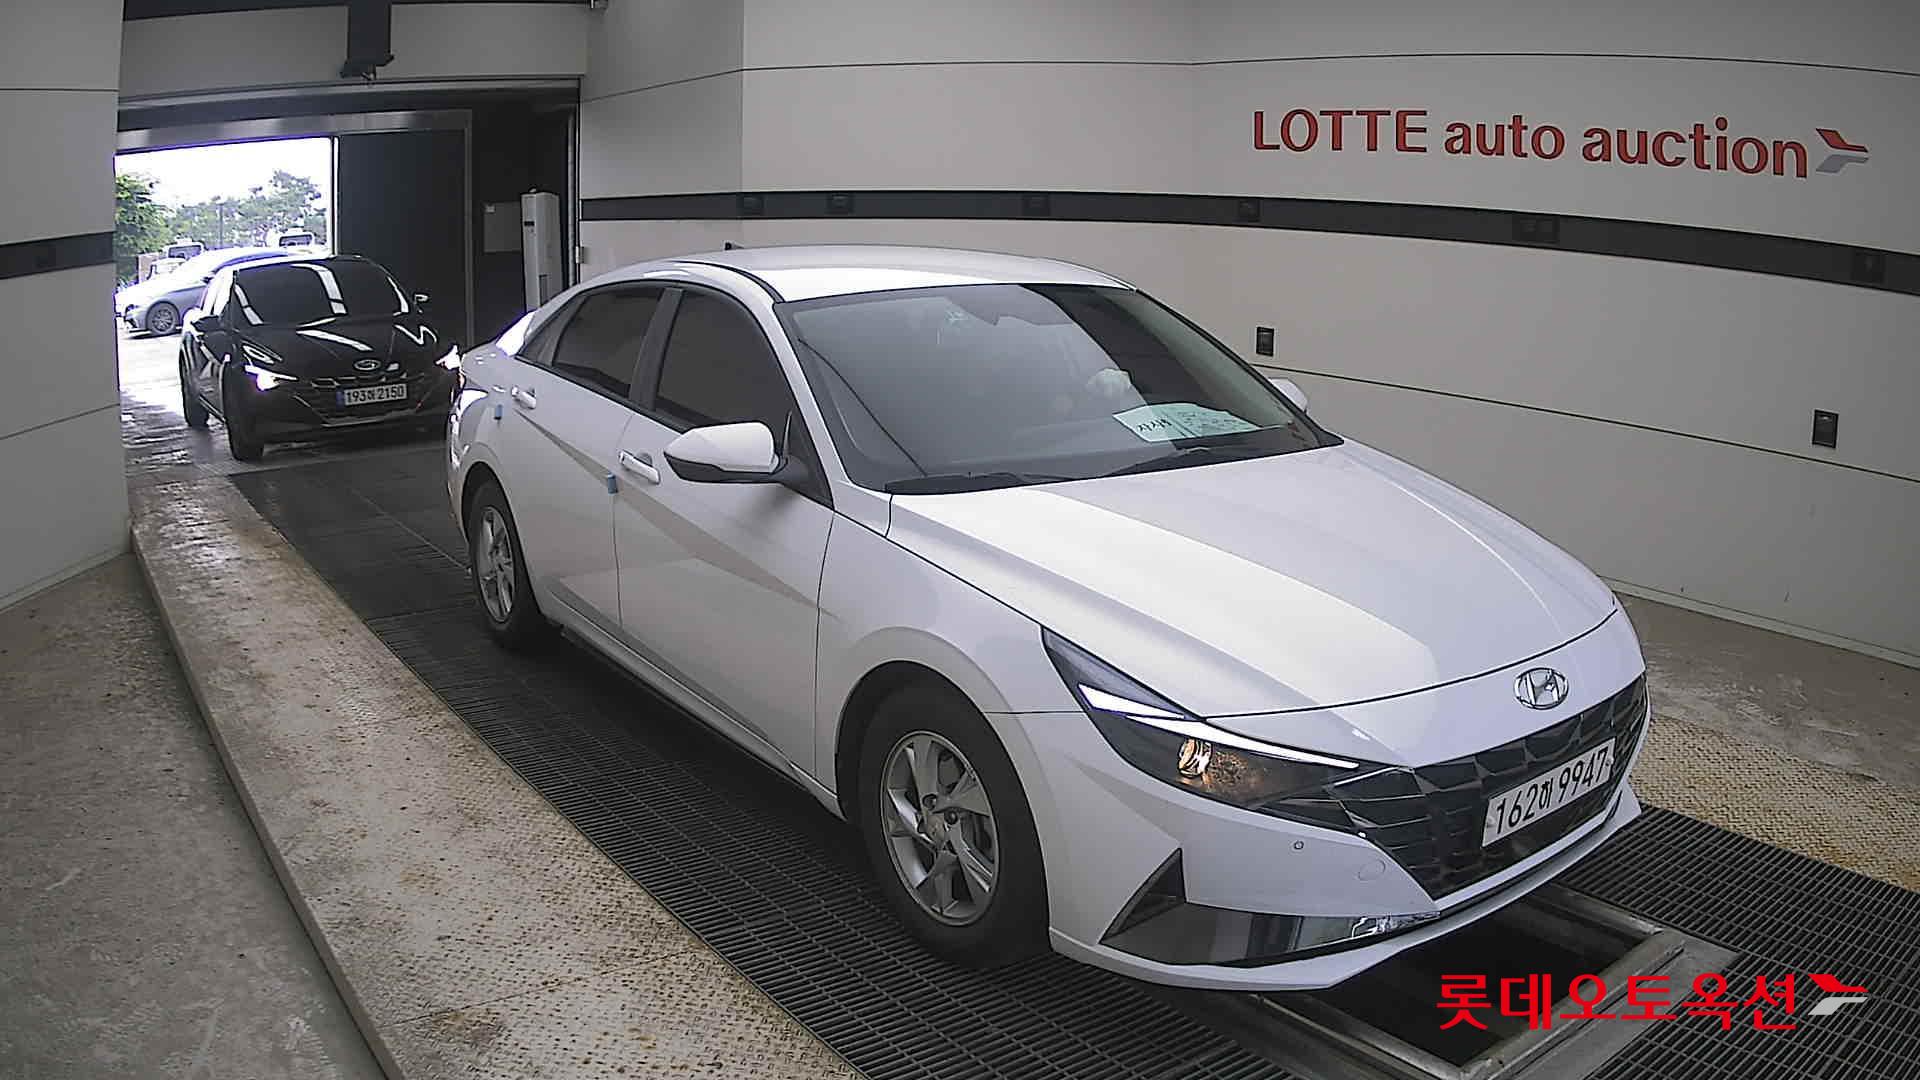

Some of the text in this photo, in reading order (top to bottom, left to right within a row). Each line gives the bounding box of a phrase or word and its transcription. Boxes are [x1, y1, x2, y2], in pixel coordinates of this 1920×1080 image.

[1253, 109, 1808, 178] LOTTE auto auction
[1559, 746, 1609, 802] 9947
